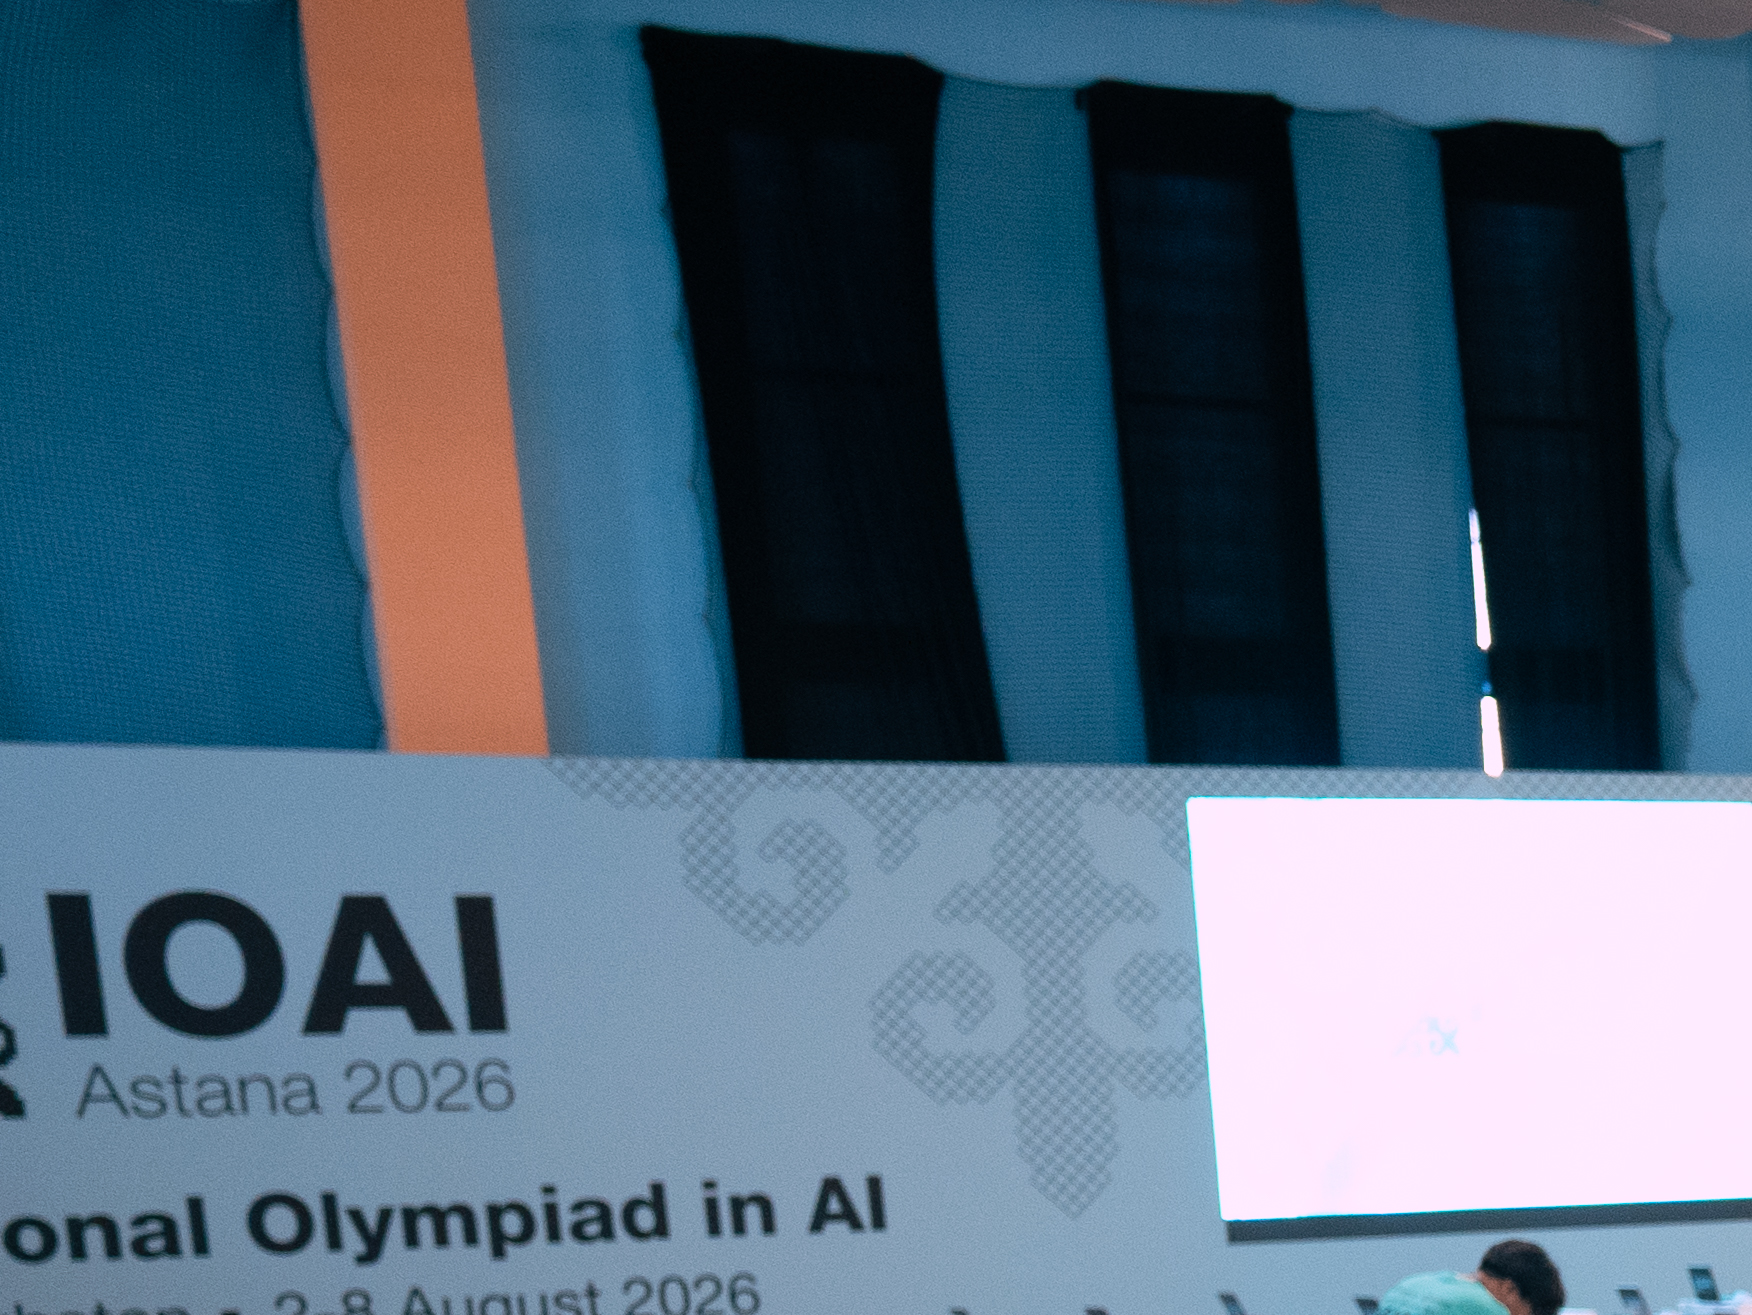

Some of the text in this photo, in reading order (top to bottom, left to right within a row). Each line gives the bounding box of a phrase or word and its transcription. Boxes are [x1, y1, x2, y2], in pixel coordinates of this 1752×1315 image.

[46, 888, 509, 1040] IOAI
[76, 1057, 516, 1119] Astana 2026
[246, 1179, 671, 1266] Olympiad
[702, 1179, 776, 1238] in
[808, 1174, 887, 1234] AI
